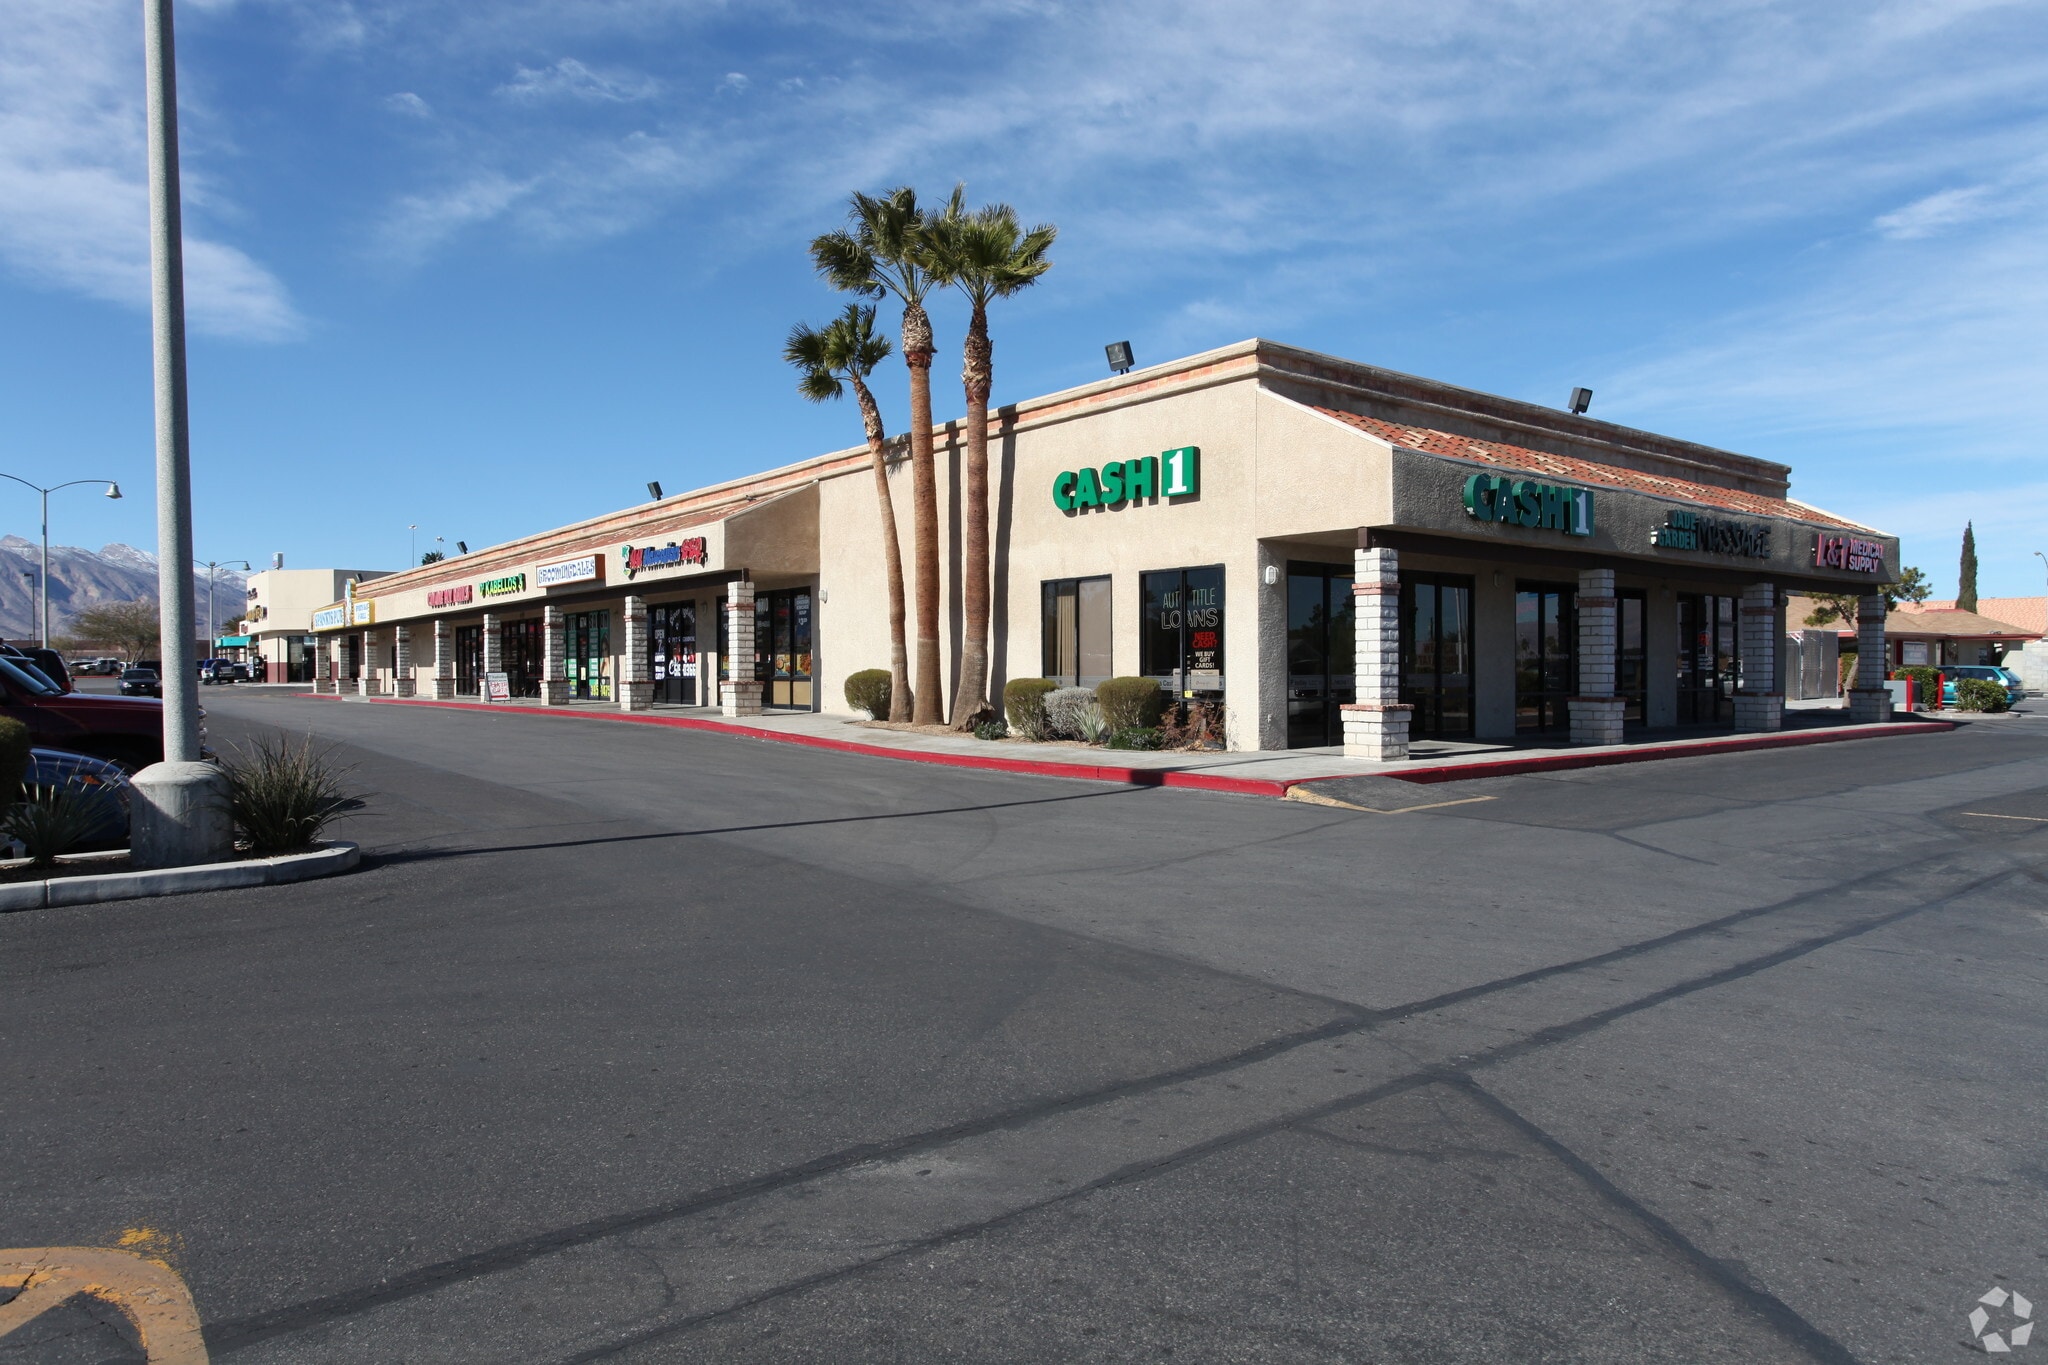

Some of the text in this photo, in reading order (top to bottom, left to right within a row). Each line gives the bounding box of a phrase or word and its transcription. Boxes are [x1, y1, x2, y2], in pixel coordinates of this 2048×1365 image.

[1053, 450, 1187, 511] CASH 1
[1467, 473, 1590, 535] CASH 1
[1671, 510, 1697, 530] JADE
[1658, 528, 1698, 551] GARDEN
[1697, 516, 1771, 558] MASSAGE
[1850, 538, 1885, 559] MEDICAL
[1849, 555, 1879, 573] SUPPLY
[1162, 588, 1216, 609] AUT TITLE
[1192, 640, 1218, 649] CASH?
[1194, 631, 1216, 641] NEED
